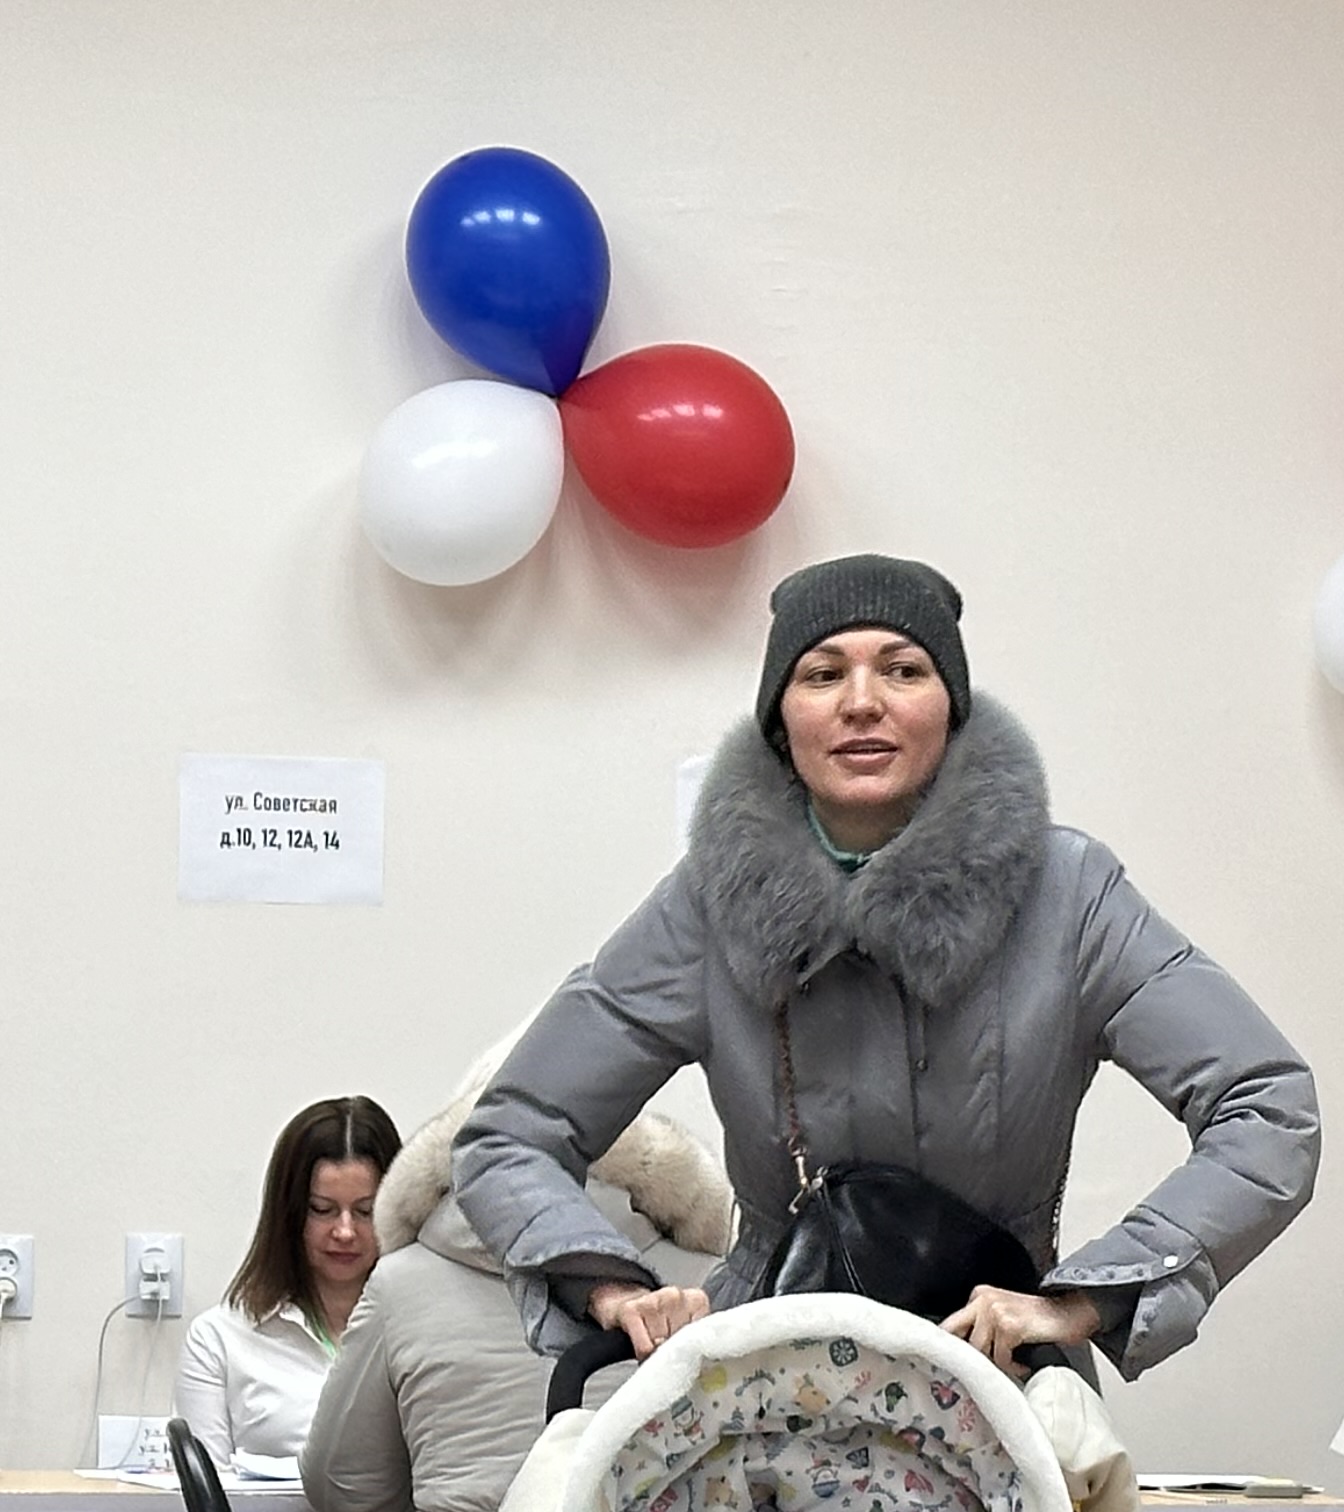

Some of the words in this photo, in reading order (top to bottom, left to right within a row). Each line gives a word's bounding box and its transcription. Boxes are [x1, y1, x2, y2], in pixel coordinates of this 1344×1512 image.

[225, 794, 249, 816] ул.
[253, 791, 338, 815] Советская
[220, 827, 256, 850] д.10,
[261, 828, 282, 851] 12,
[323, 830, 340, 850] 14
